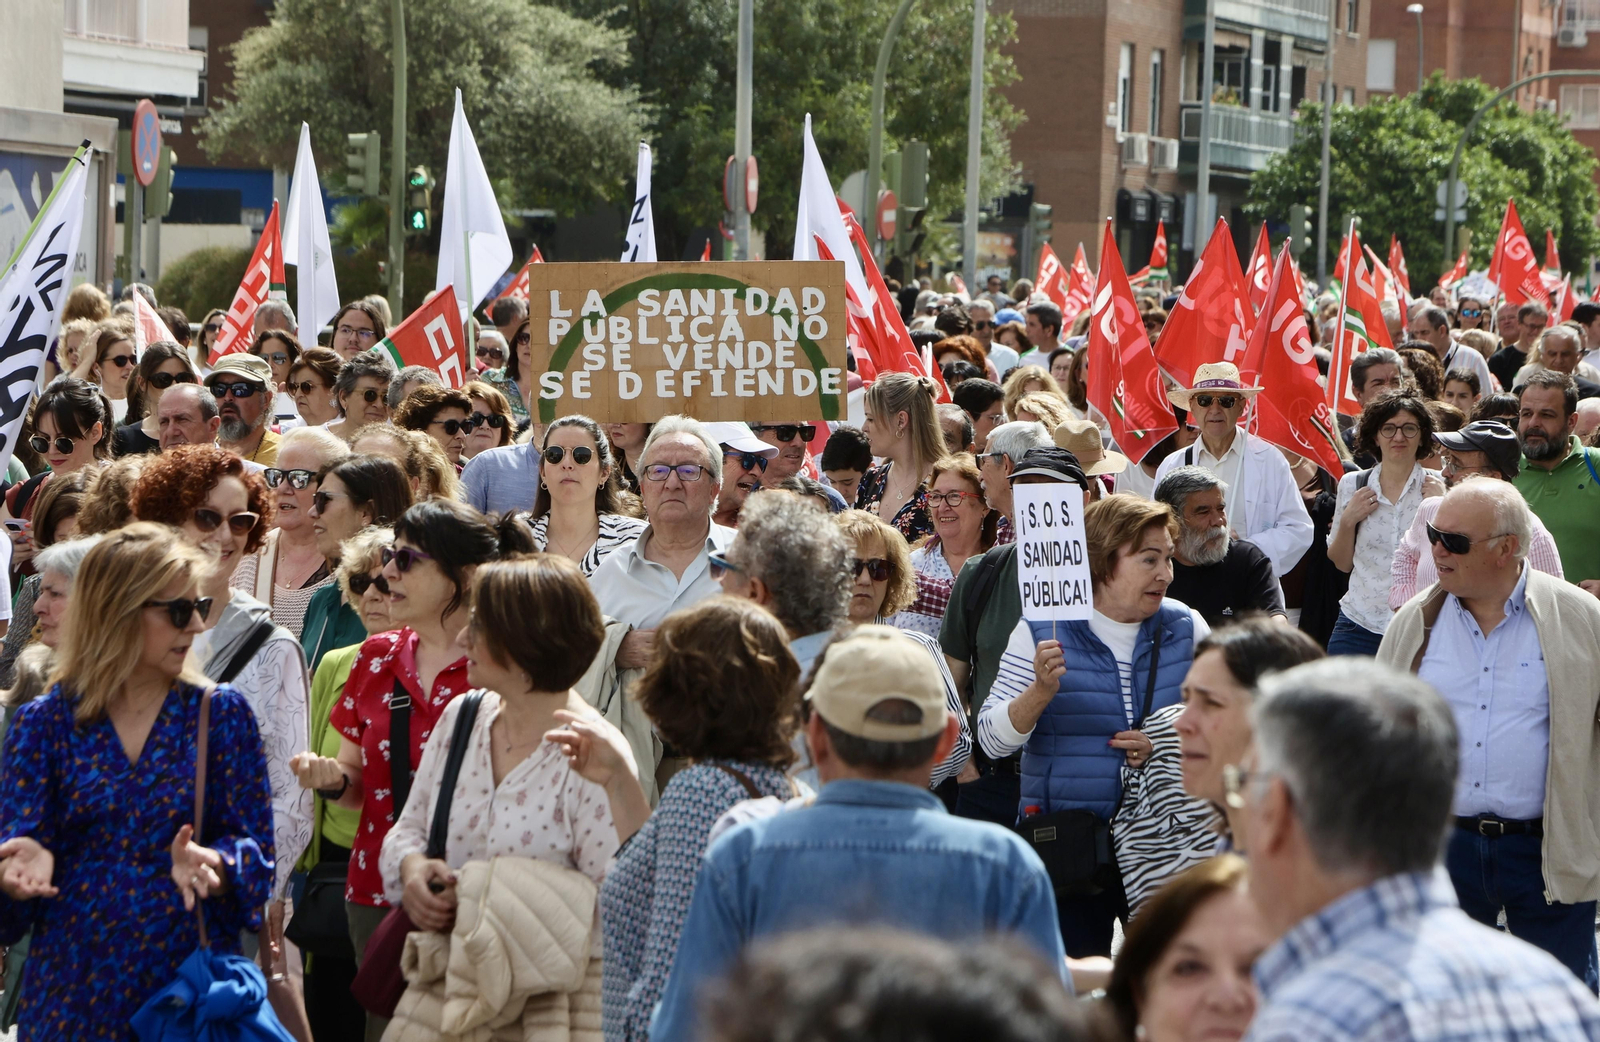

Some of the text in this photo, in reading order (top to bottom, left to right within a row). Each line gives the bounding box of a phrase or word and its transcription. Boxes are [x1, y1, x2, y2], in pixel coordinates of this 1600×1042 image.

[550, 286, 826, 318] LA SANIDAD
[548, 315, 745, 346] PUBLICA
[772, 314, 829, 342] NO
[582, 340, 796, 372] SE VENDE
[539, 370, 593, 399] SE
[1023, 540, 1083, 569] SANIDAD
[1023, 574, 1088, 608] PÚBLICA!
